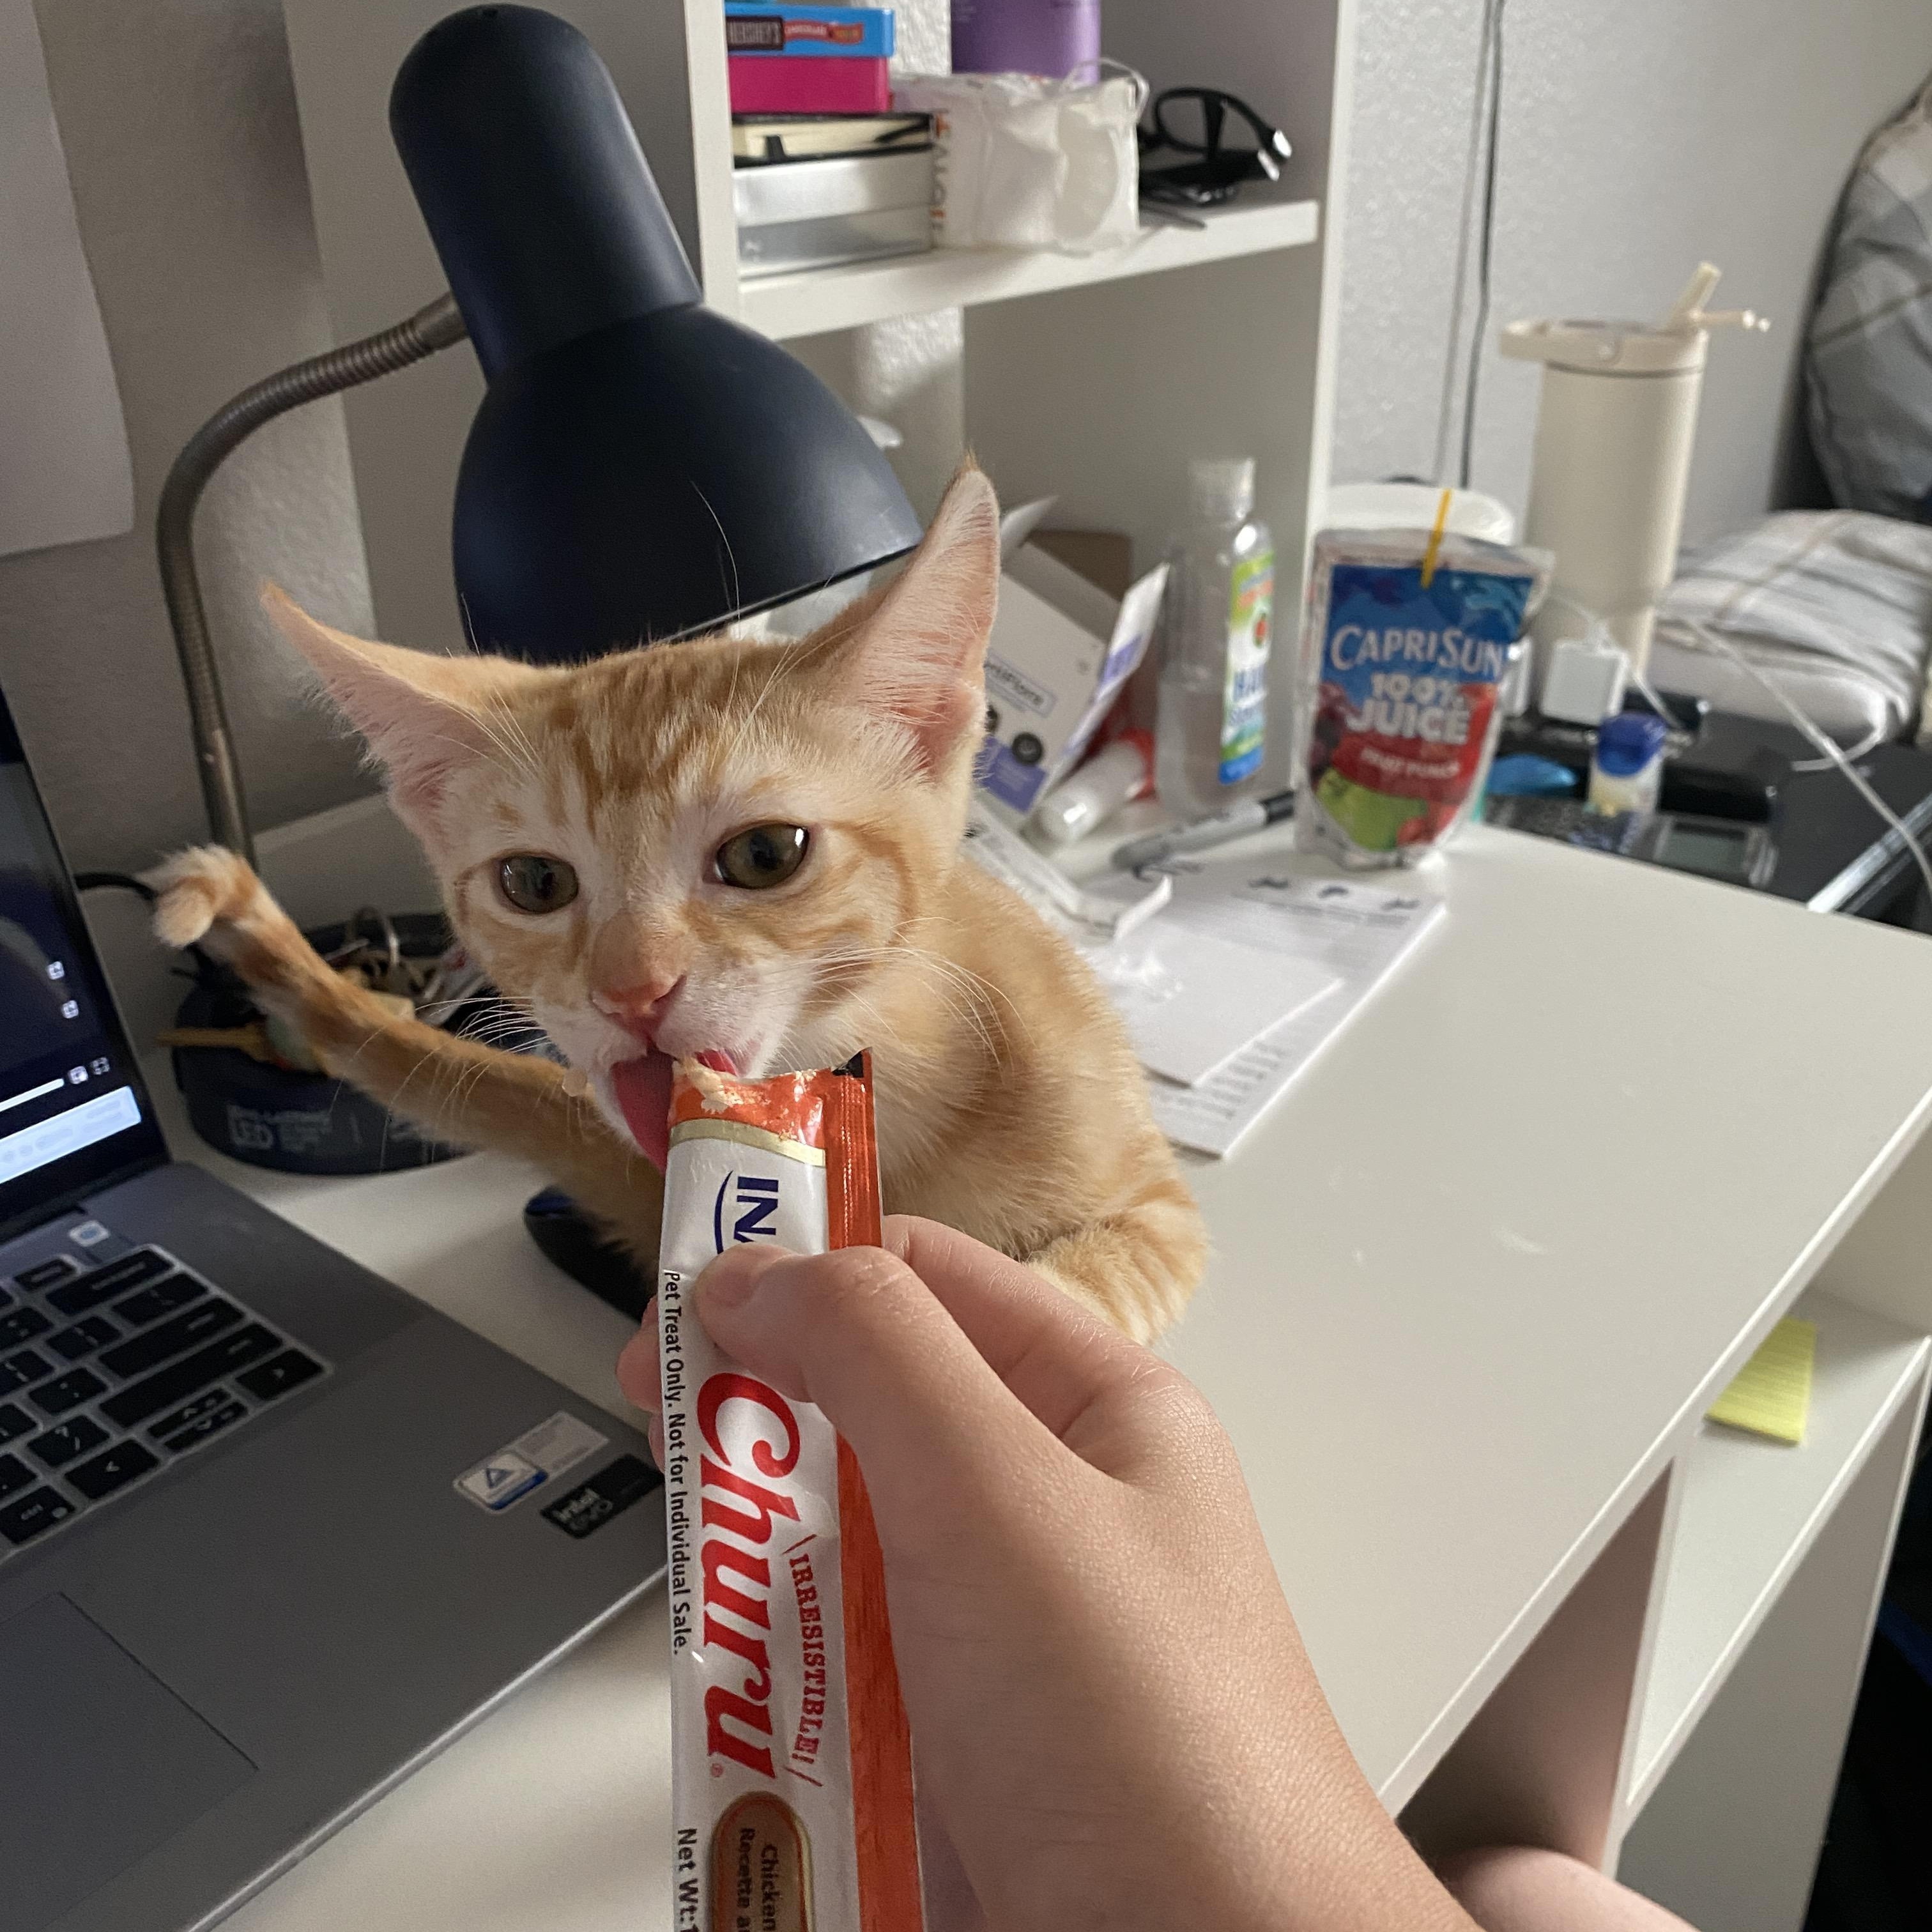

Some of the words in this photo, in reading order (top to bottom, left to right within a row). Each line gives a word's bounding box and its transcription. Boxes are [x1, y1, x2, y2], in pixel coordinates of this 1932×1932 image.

[1371, 672, 1466, 710] 100%
[1344, 699, 1468, 746] JUICE
[664, 1270, 681, 1301] Pet
[665, 1306, 682, 1354] Treat
[664, 1358, 686, 1407] Only.
[669, 1413, 686, 1450] Not
[670, 1455, 689, 1484] for
[671, 1491, 691, 1596] Individual
[673, 1602, 692, 1655] Sale.
[677, 1828, 697, 1872] Net
[761, 1843, 781, 1931] Chicken
